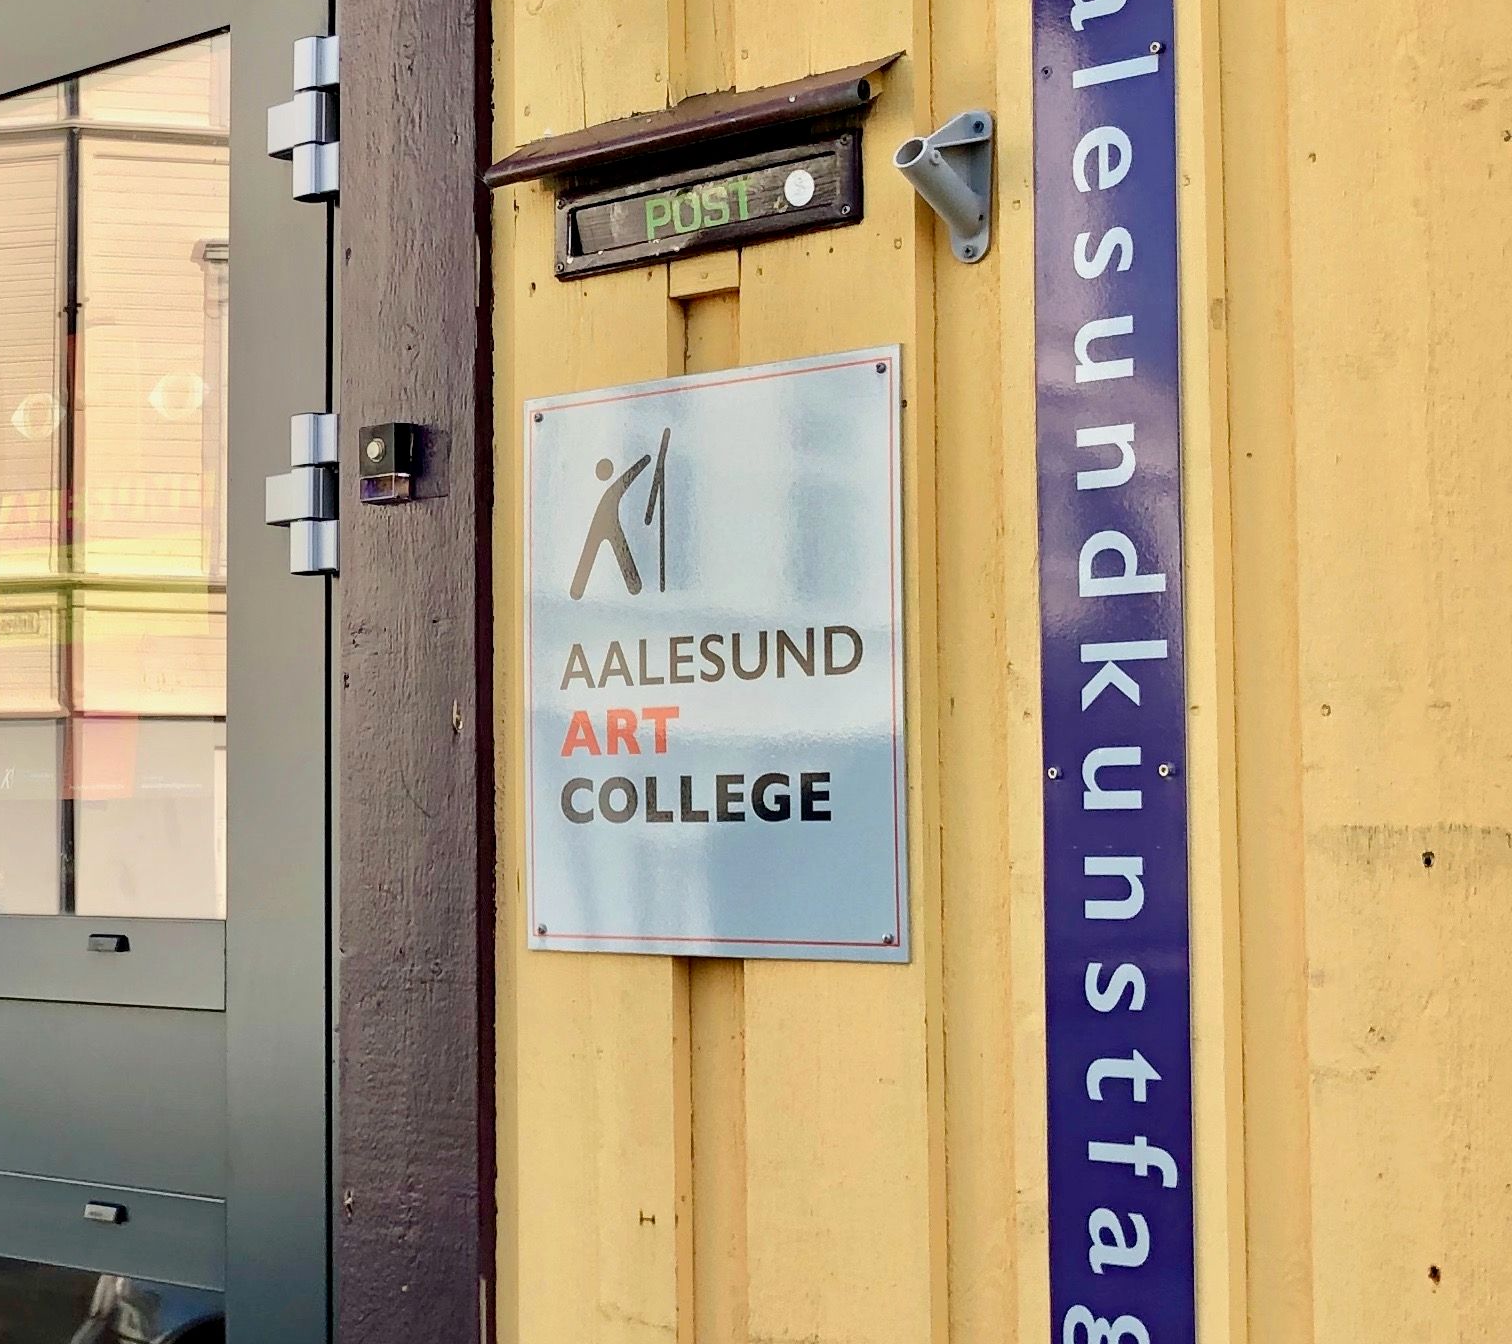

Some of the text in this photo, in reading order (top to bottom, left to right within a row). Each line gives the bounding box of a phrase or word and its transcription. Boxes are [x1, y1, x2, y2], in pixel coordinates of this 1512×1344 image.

[645, 181, 749, 240] POST
[560, 624, 864, 690] AALESUND
[560, 705, 680, 757] ART
[560, 771, 833, 823] COLLEGE
